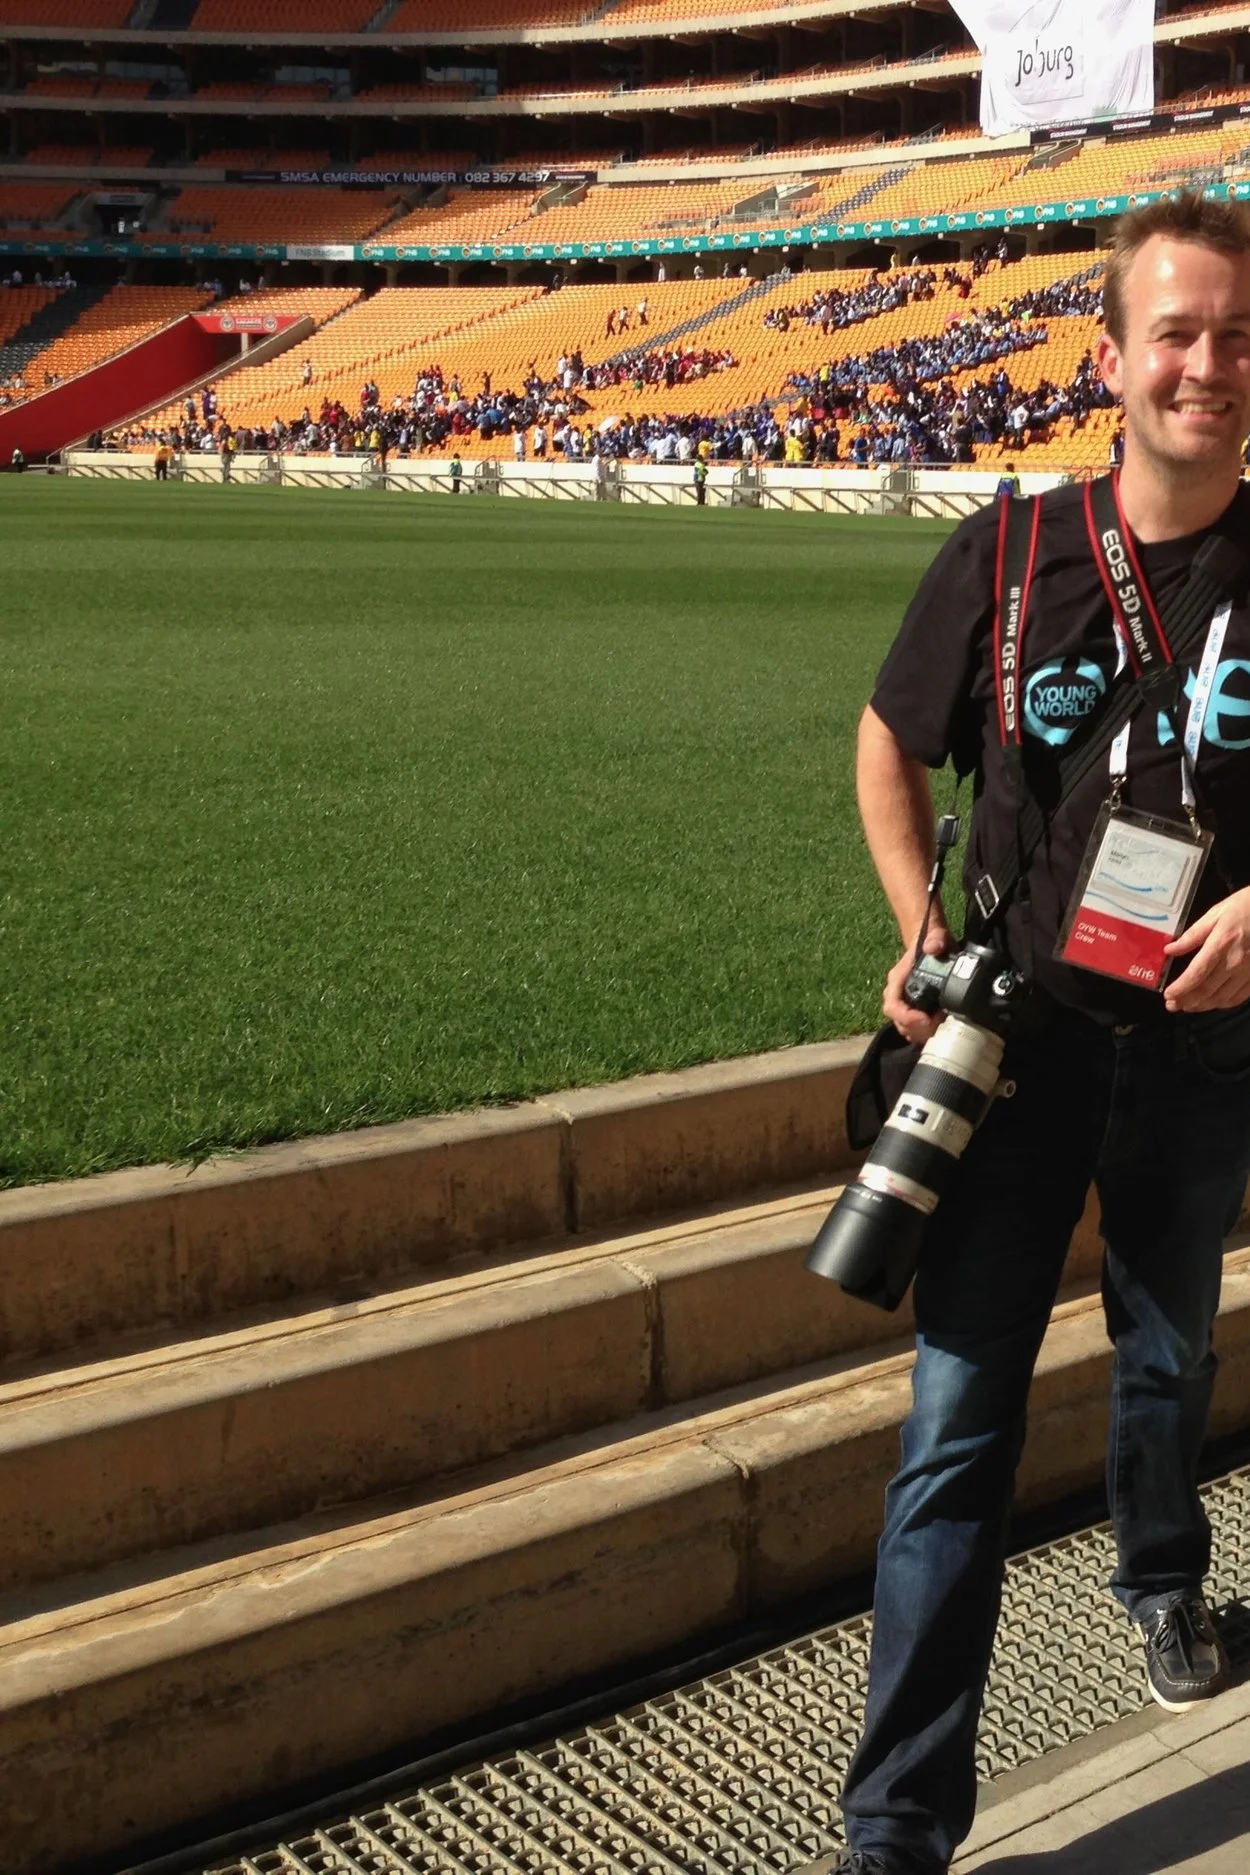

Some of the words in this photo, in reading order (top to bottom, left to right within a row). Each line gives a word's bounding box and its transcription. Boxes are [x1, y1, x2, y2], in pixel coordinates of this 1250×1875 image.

[322, 171, 400, 183] EMERGENCY
[403, 171, 456, 183] NUMBER
[465, 171, 490, 183] 082
[493, 171, 514, 183] 367
[518, 170, 549, 183] 4297
[1236, 185, 1249, 194] FNB
[1105, 201, 1116, 210] FNB
[1136, 196, 1148, 206] FNB
[1101, 529, 1131, 582] EOS
[1009, 586, 1021, 599] III
[1118, 584, 1141, 614] 5D
[1006, 601, 1020, 637] Mark
[1129, 616, 1149, 653] Mark
[1002, 642, 1016, 671] 5D
[1141, 652, 1153, 663] II
[1035, 684, 1097, 702] YOUNG
[1003, 676, 1015, 732] EOS
[1034, 700, 1096, 717] WORLD
[1074, 931, 1096, 944] Crew
[1097, 927, 1118, 942] Team
